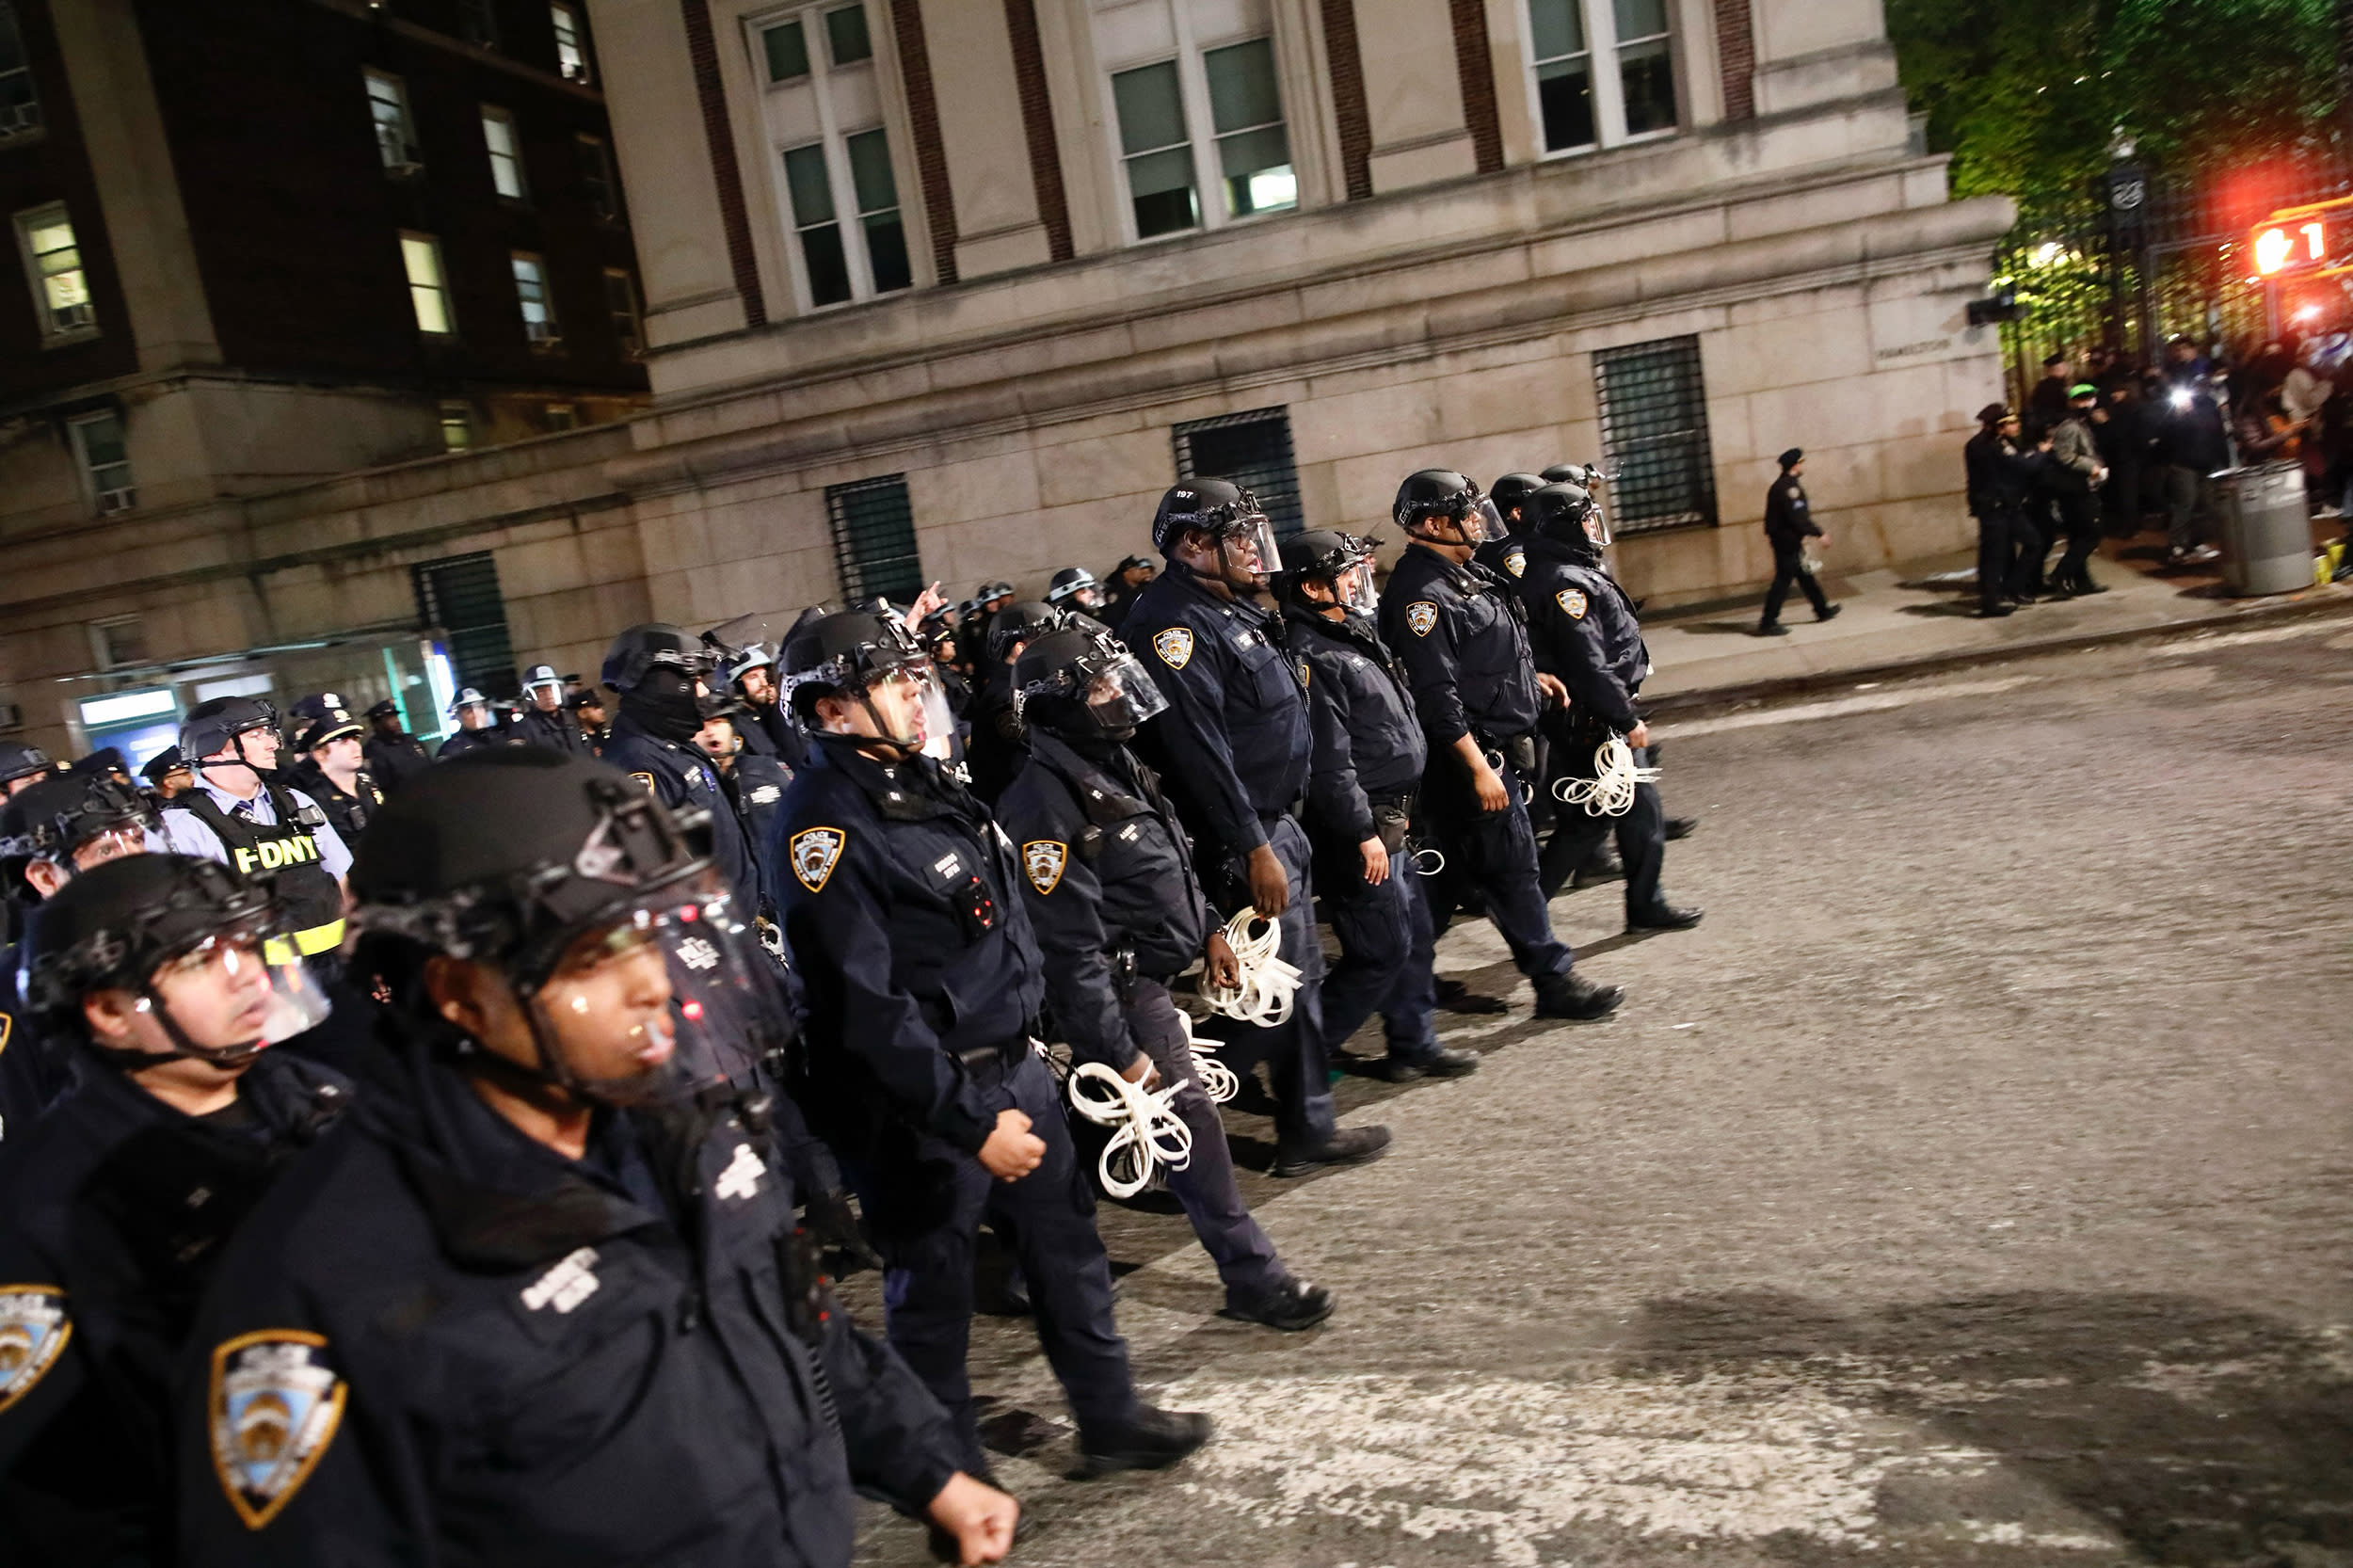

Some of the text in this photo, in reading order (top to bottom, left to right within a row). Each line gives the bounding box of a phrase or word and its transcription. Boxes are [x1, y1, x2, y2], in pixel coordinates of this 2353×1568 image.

[2299, 222, 2324, 260] 1
[1176, 489, 1193, 499] 197
[234, 835, 318, 874] FDNY
